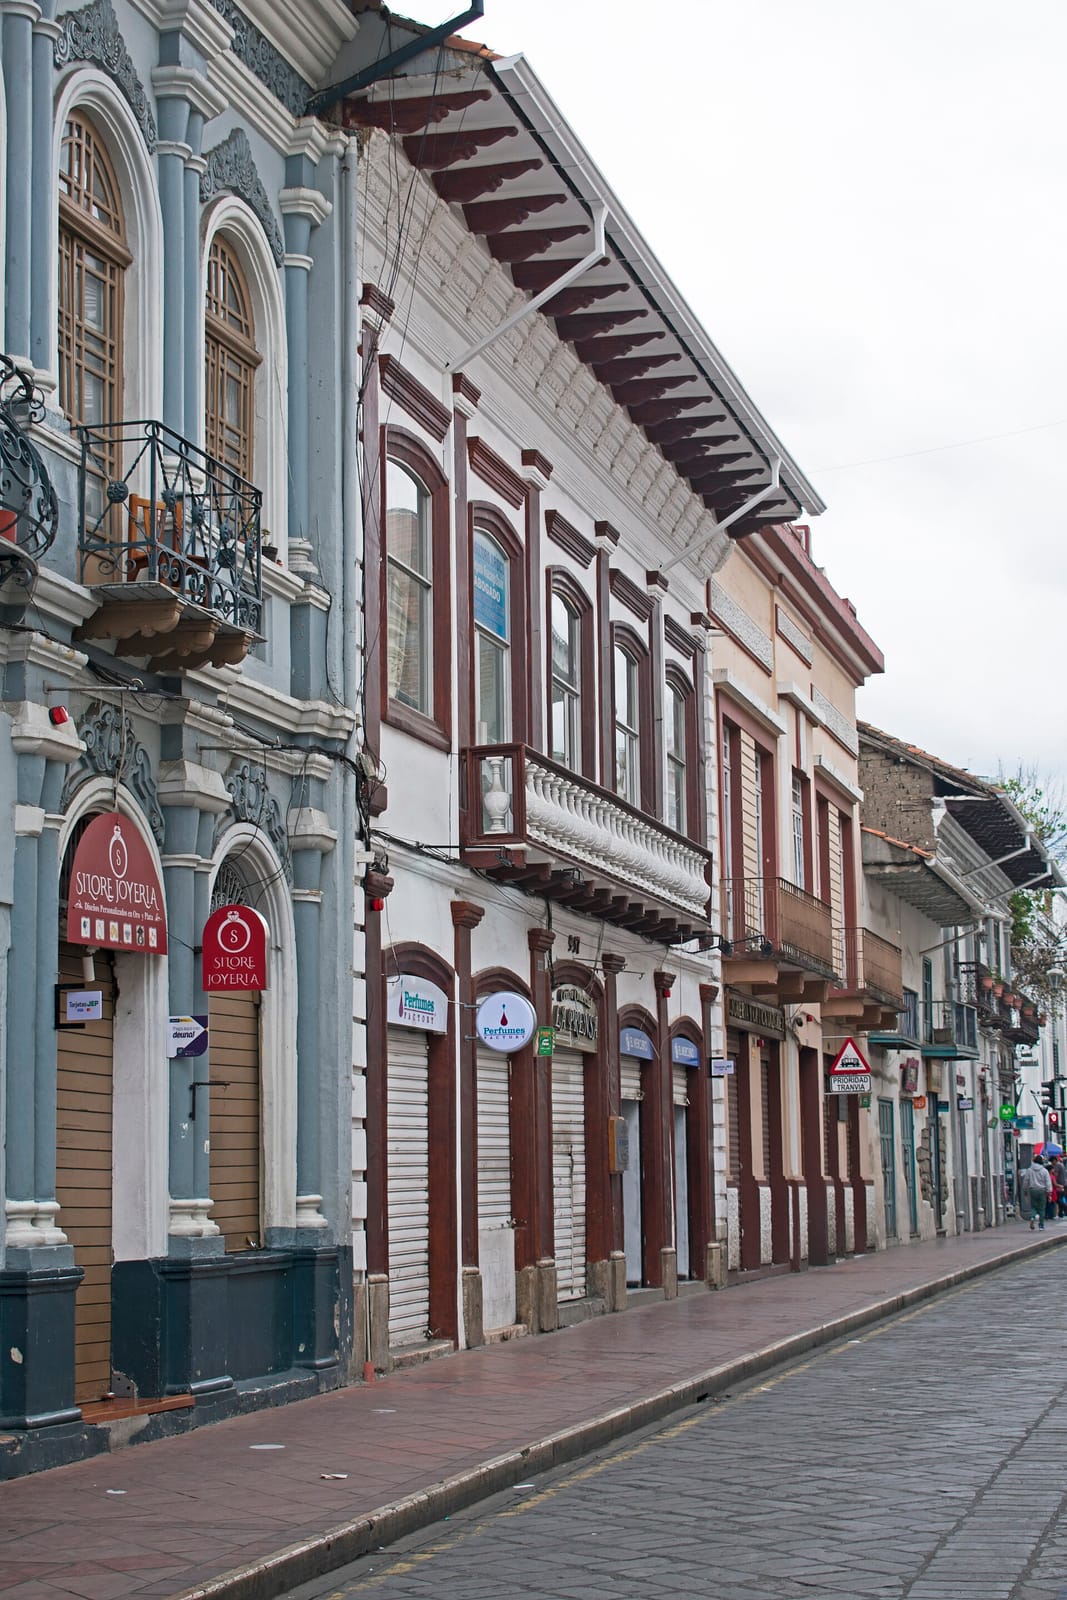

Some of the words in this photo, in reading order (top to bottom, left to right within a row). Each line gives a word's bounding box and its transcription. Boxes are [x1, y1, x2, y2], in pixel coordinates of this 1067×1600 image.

[116, 879, 160, 911] JOYERIA
[208, 973, 261, 987] JOYERIA
[404, 991, 435, 1012] Perfumes
[483, 1027, 526, 1035] Perfumes
[832, 1076, 869, 1084] PRIORIDAD
